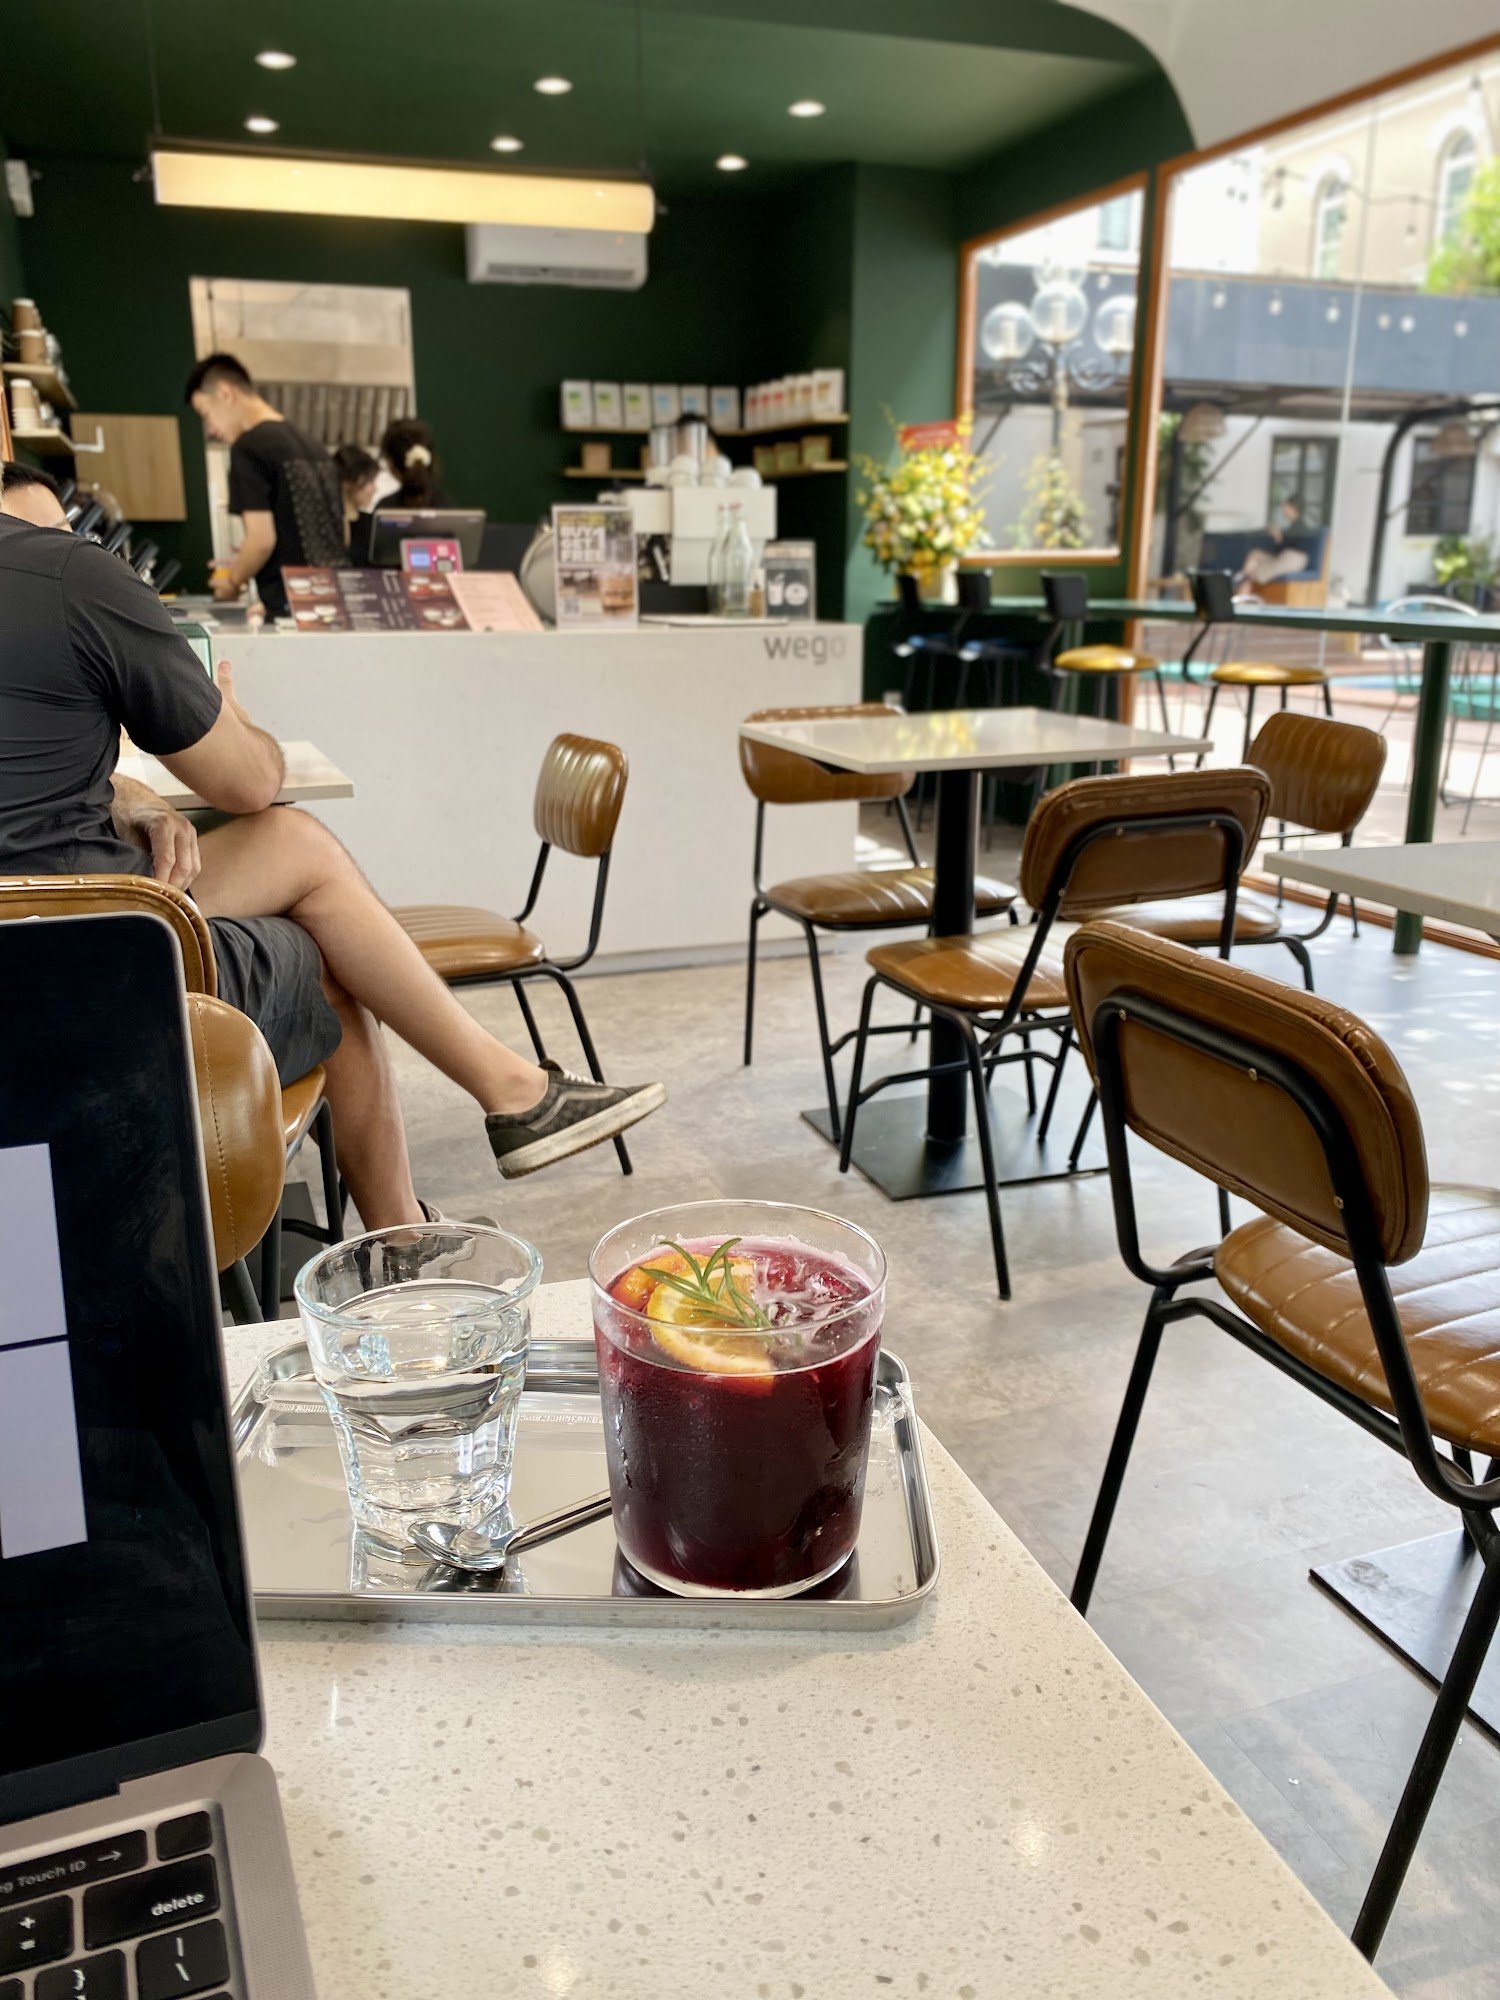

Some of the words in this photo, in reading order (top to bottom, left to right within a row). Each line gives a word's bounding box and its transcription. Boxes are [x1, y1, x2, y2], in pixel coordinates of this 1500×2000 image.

[560, 526, 592, 538] BUY
[560, 550, 606, 562] FREE
[764, 634, 847, 666] wego
[17, 1867, 66, 1887] Touch
[69, 1860, 87, 1873] ID
[151, 1893, 206, 1916] delete
